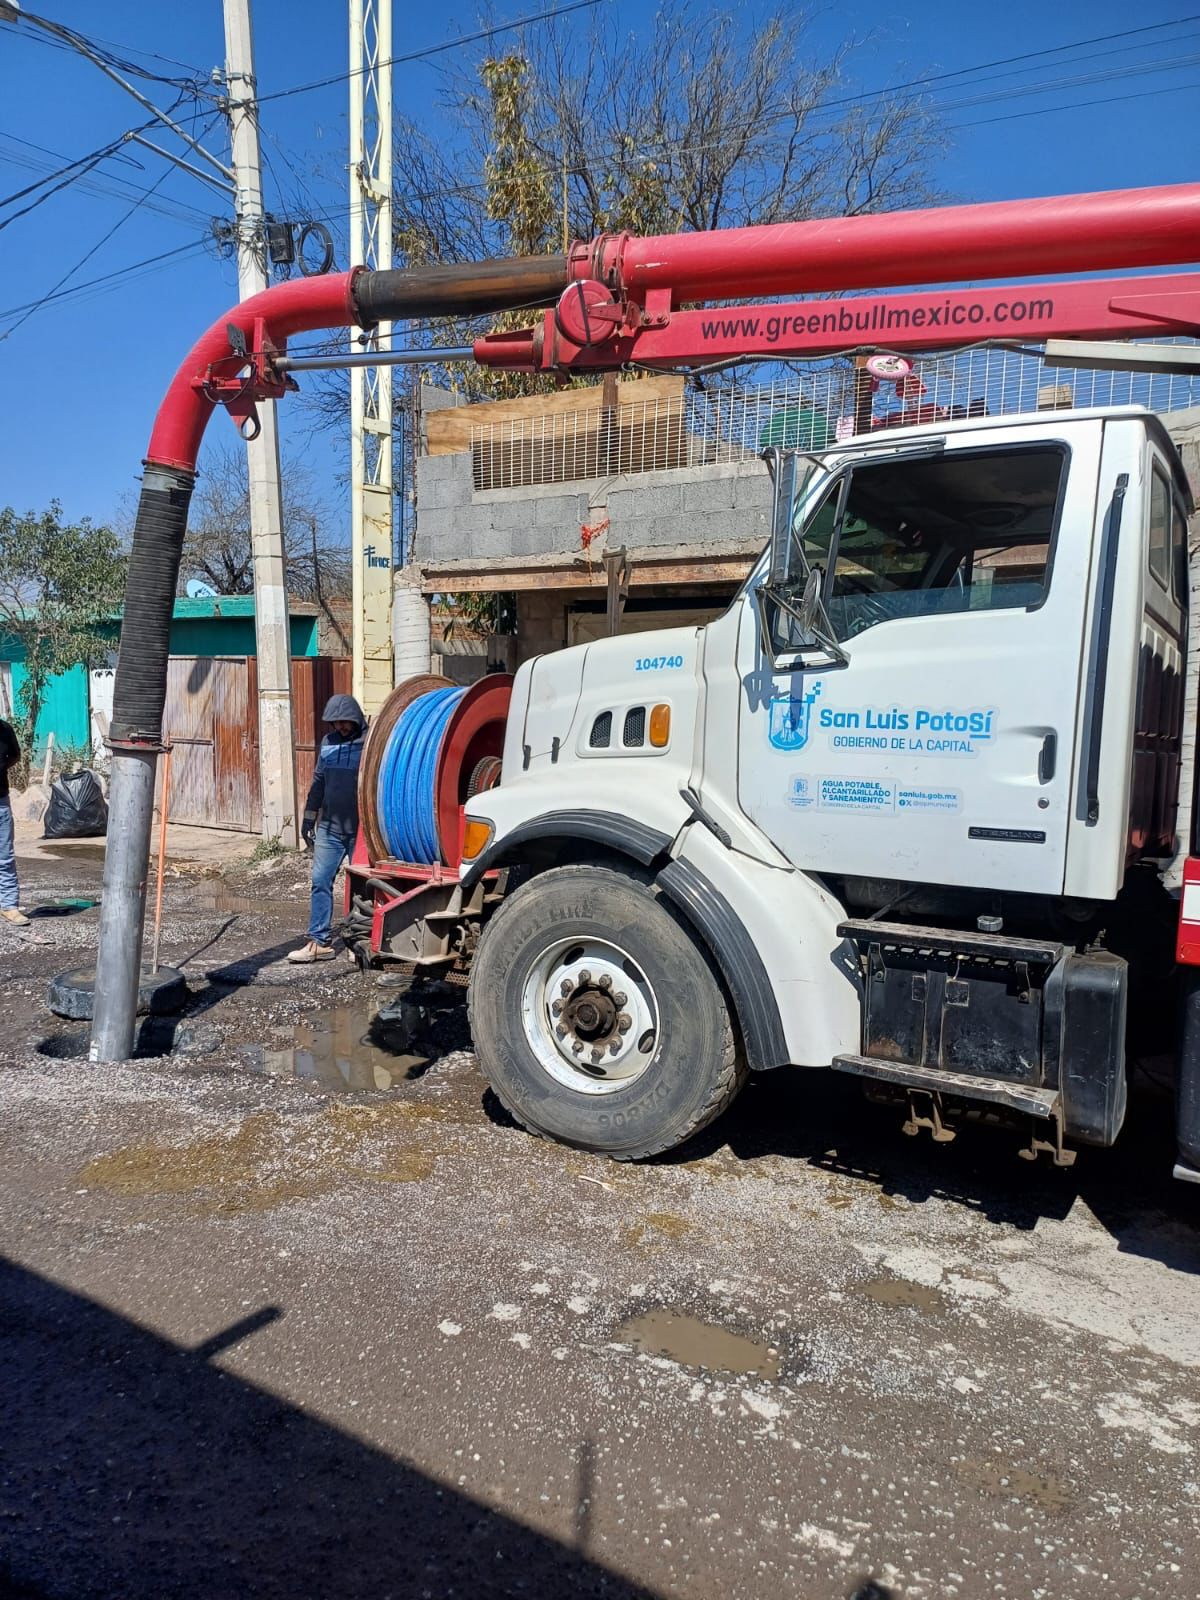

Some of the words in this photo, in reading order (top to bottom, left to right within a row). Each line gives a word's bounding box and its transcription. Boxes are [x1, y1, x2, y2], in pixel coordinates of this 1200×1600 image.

[701, 299, 1054, 342] www.greenbullmexico.com
[635, 655, 683, 671] 104740
[819, 709, 860, 728] San
[866, 709, 909, 729] Luis
[915, 710, 993, 733] PotoSí
[833, 736, 888, 749] GOBIERNO
[891, 738, 905, 749] DE
[909, 739, 923, 750] LA
[926, 740, 974, 752] CAPITAL
[822, 787, 890, 797] ALCANTARILLADO
[899, 791, 957, 800] sanluis.gob.mx
